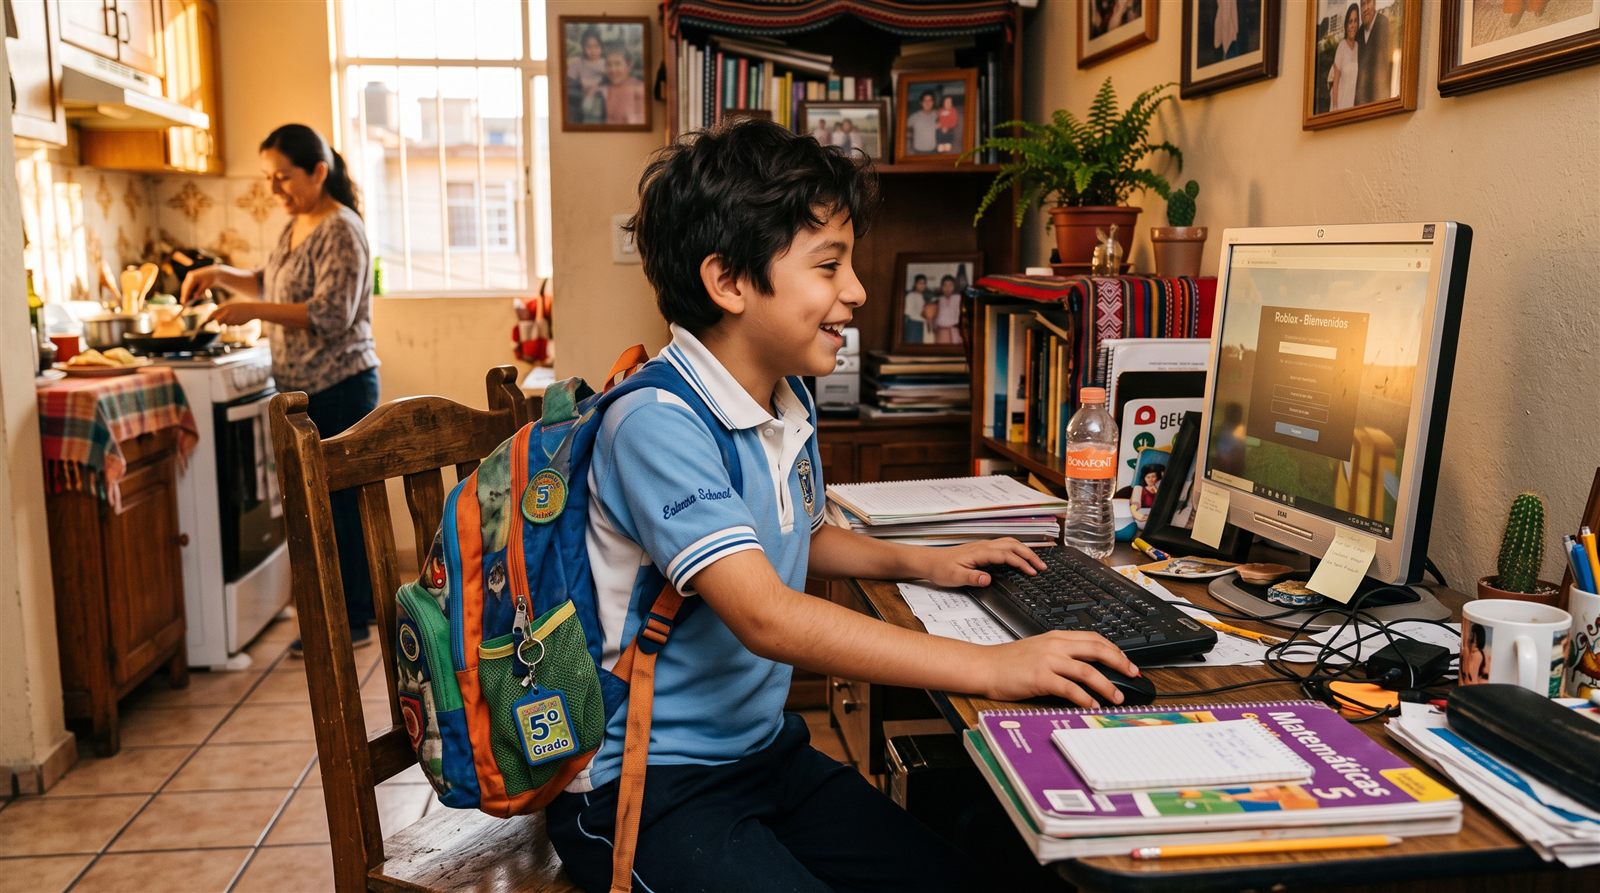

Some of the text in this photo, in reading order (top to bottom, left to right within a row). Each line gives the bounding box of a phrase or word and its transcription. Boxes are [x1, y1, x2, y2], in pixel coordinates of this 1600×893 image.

[532, 738, 569, 756] Grado
[1267, 711, 1391, 797] Matemáticas
[1312, 786, 1357, 800] 5
